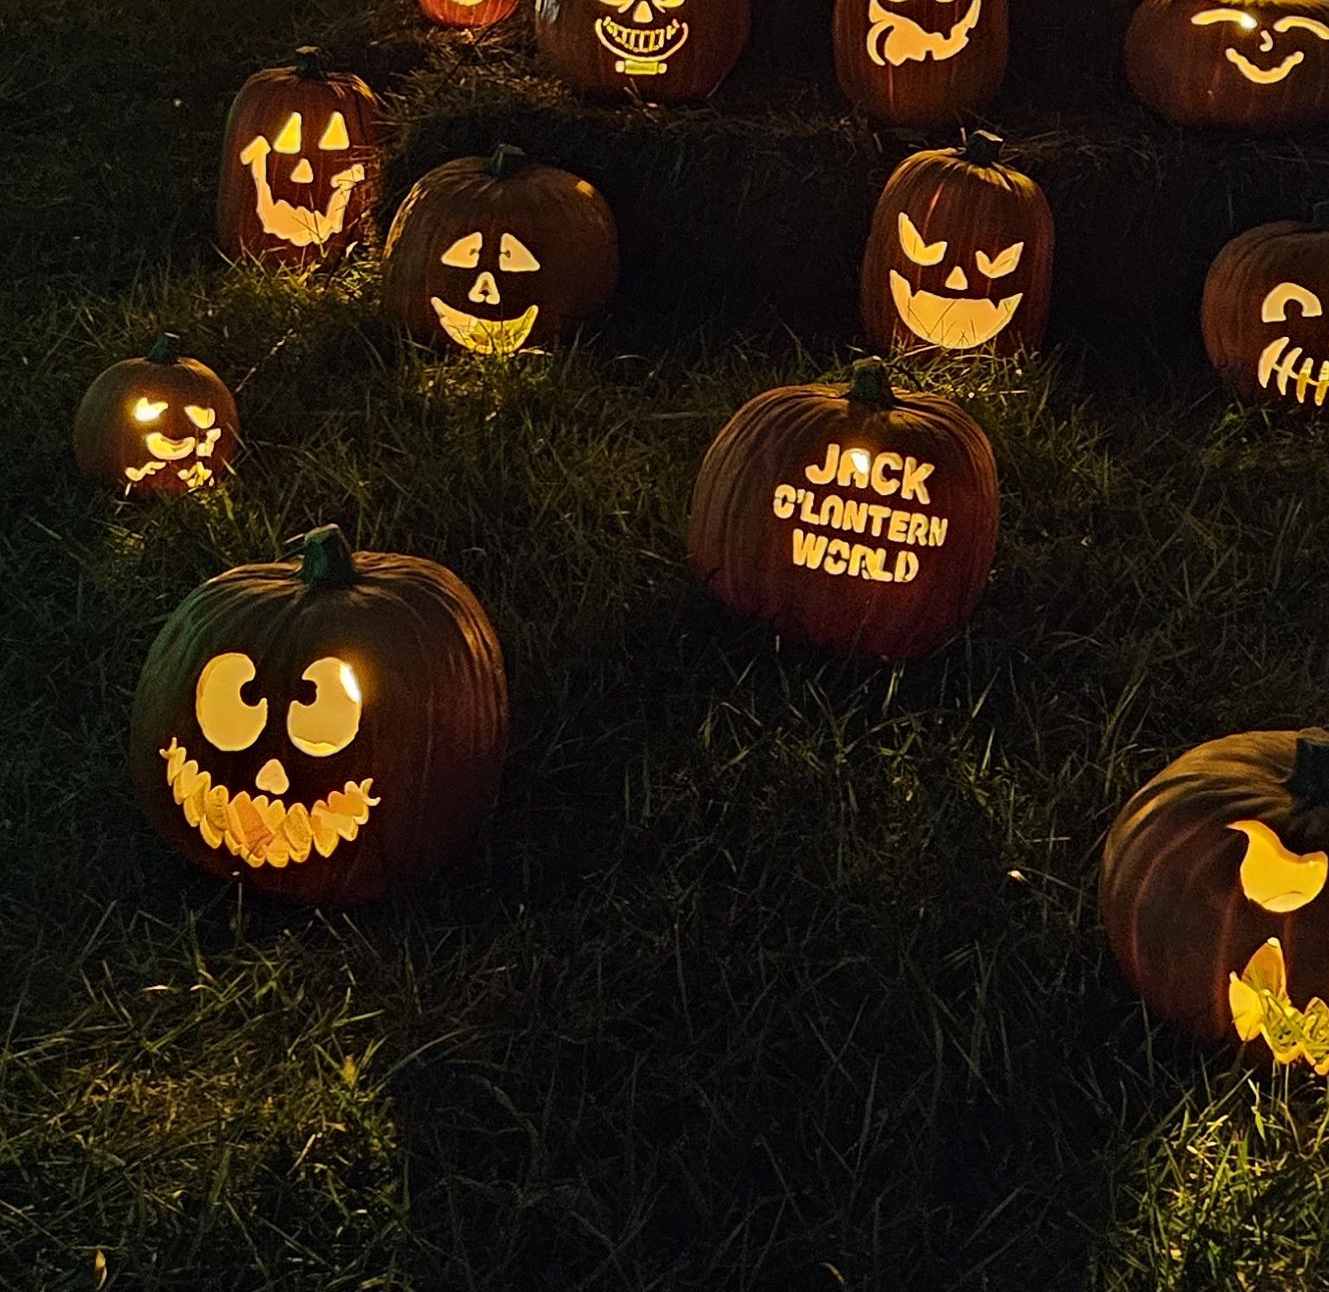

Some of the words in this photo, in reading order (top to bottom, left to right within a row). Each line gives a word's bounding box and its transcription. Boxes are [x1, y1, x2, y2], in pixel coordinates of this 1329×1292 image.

[804, 443, 936, 506] JACK
[772, 484, 949, 548] O'LANTERN
[791, 529, 920, 583] WORLD
